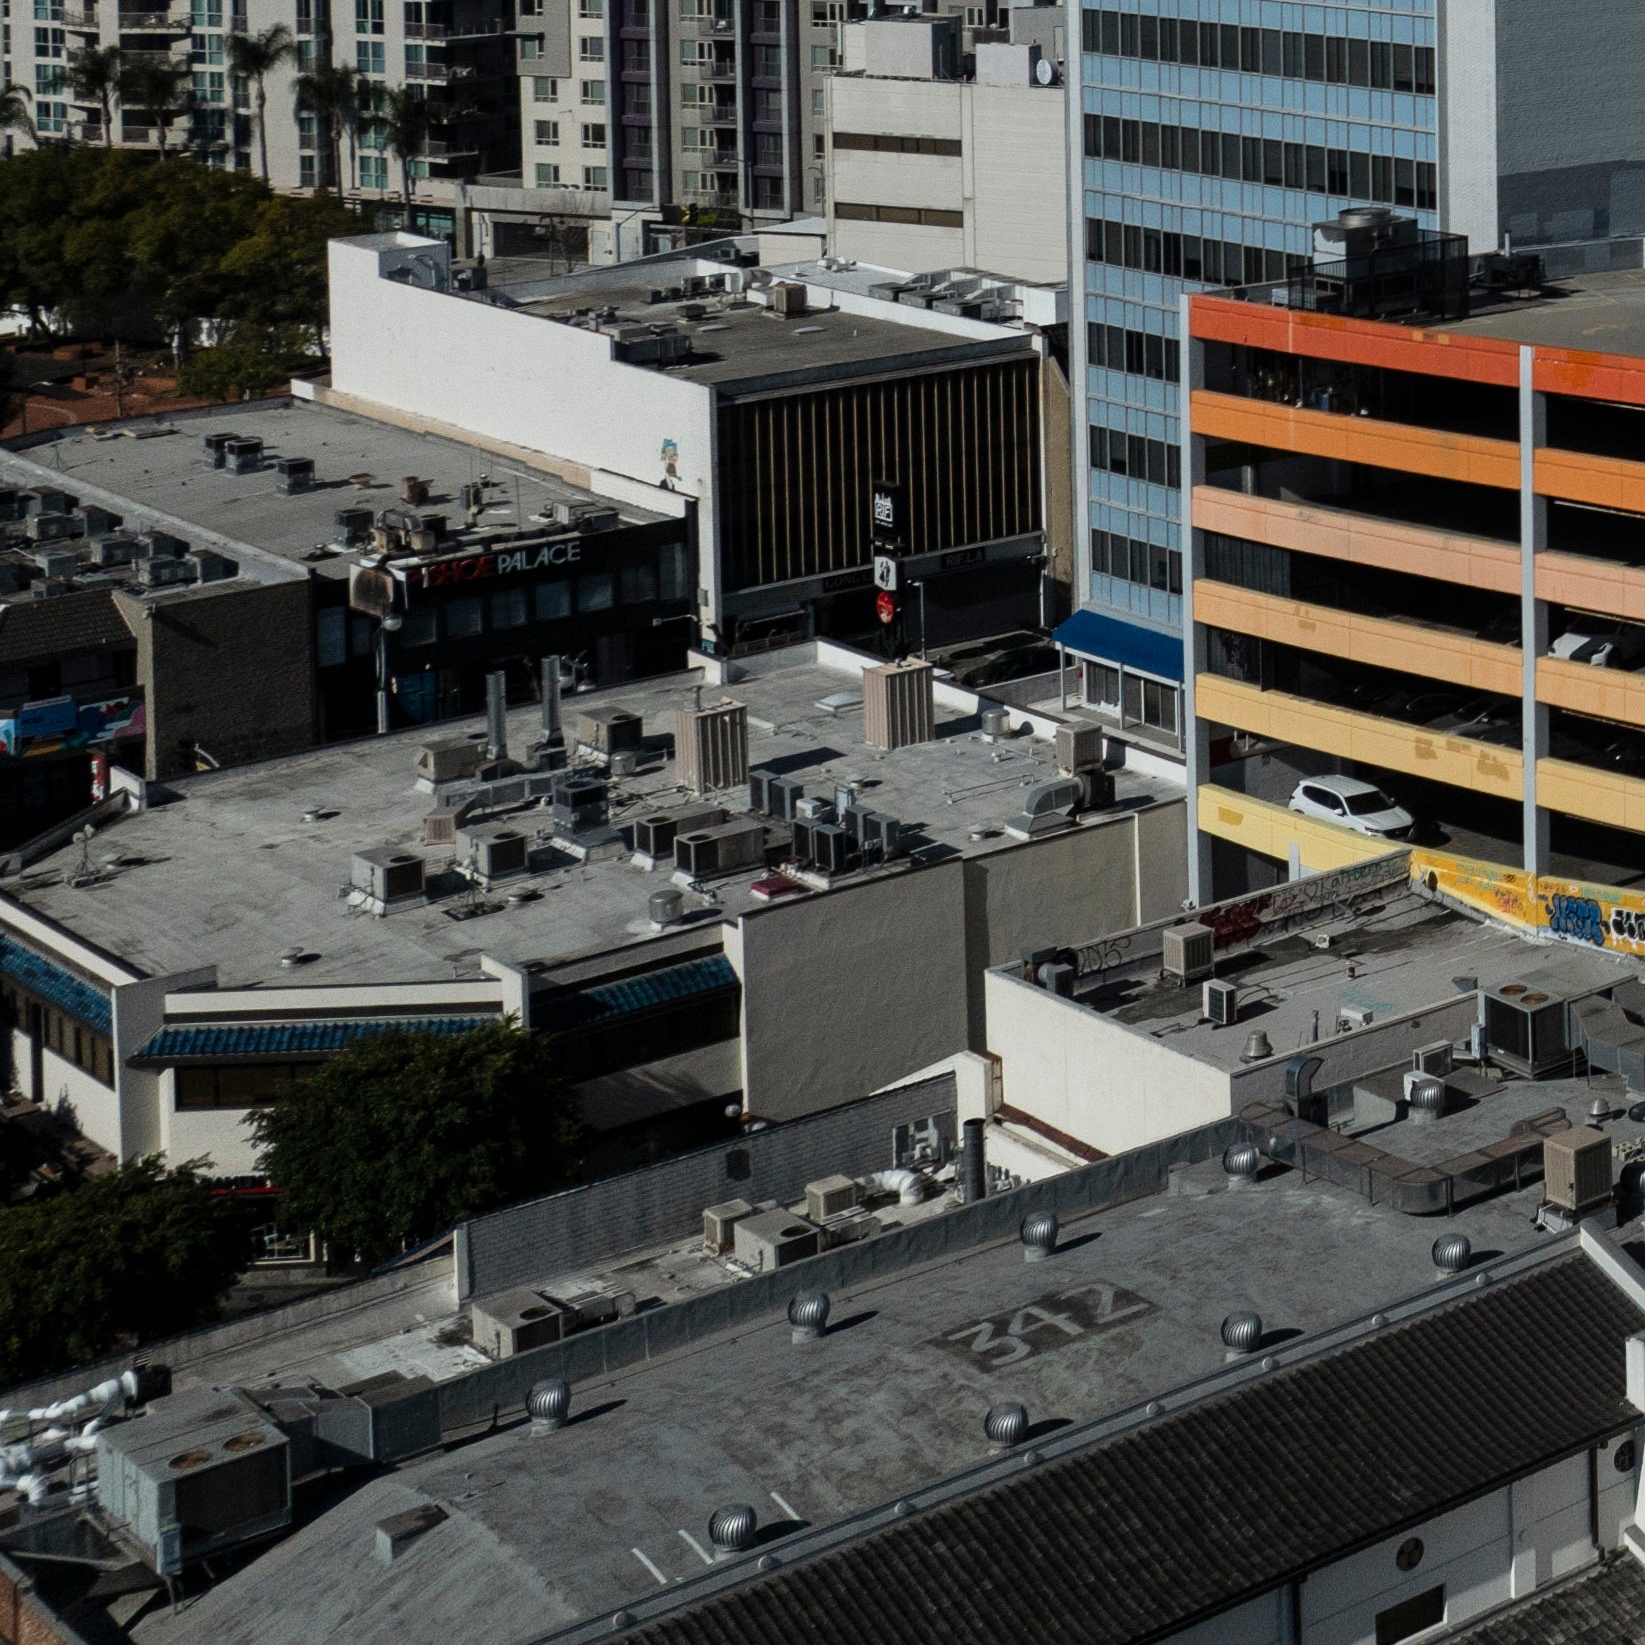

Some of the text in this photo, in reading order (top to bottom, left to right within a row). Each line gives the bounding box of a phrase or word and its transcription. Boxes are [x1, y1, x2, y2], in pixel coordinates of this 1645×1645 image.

[429, 540, 582, 586] SHOE PALACE
[943, 1282, 1146, 1367] 342
